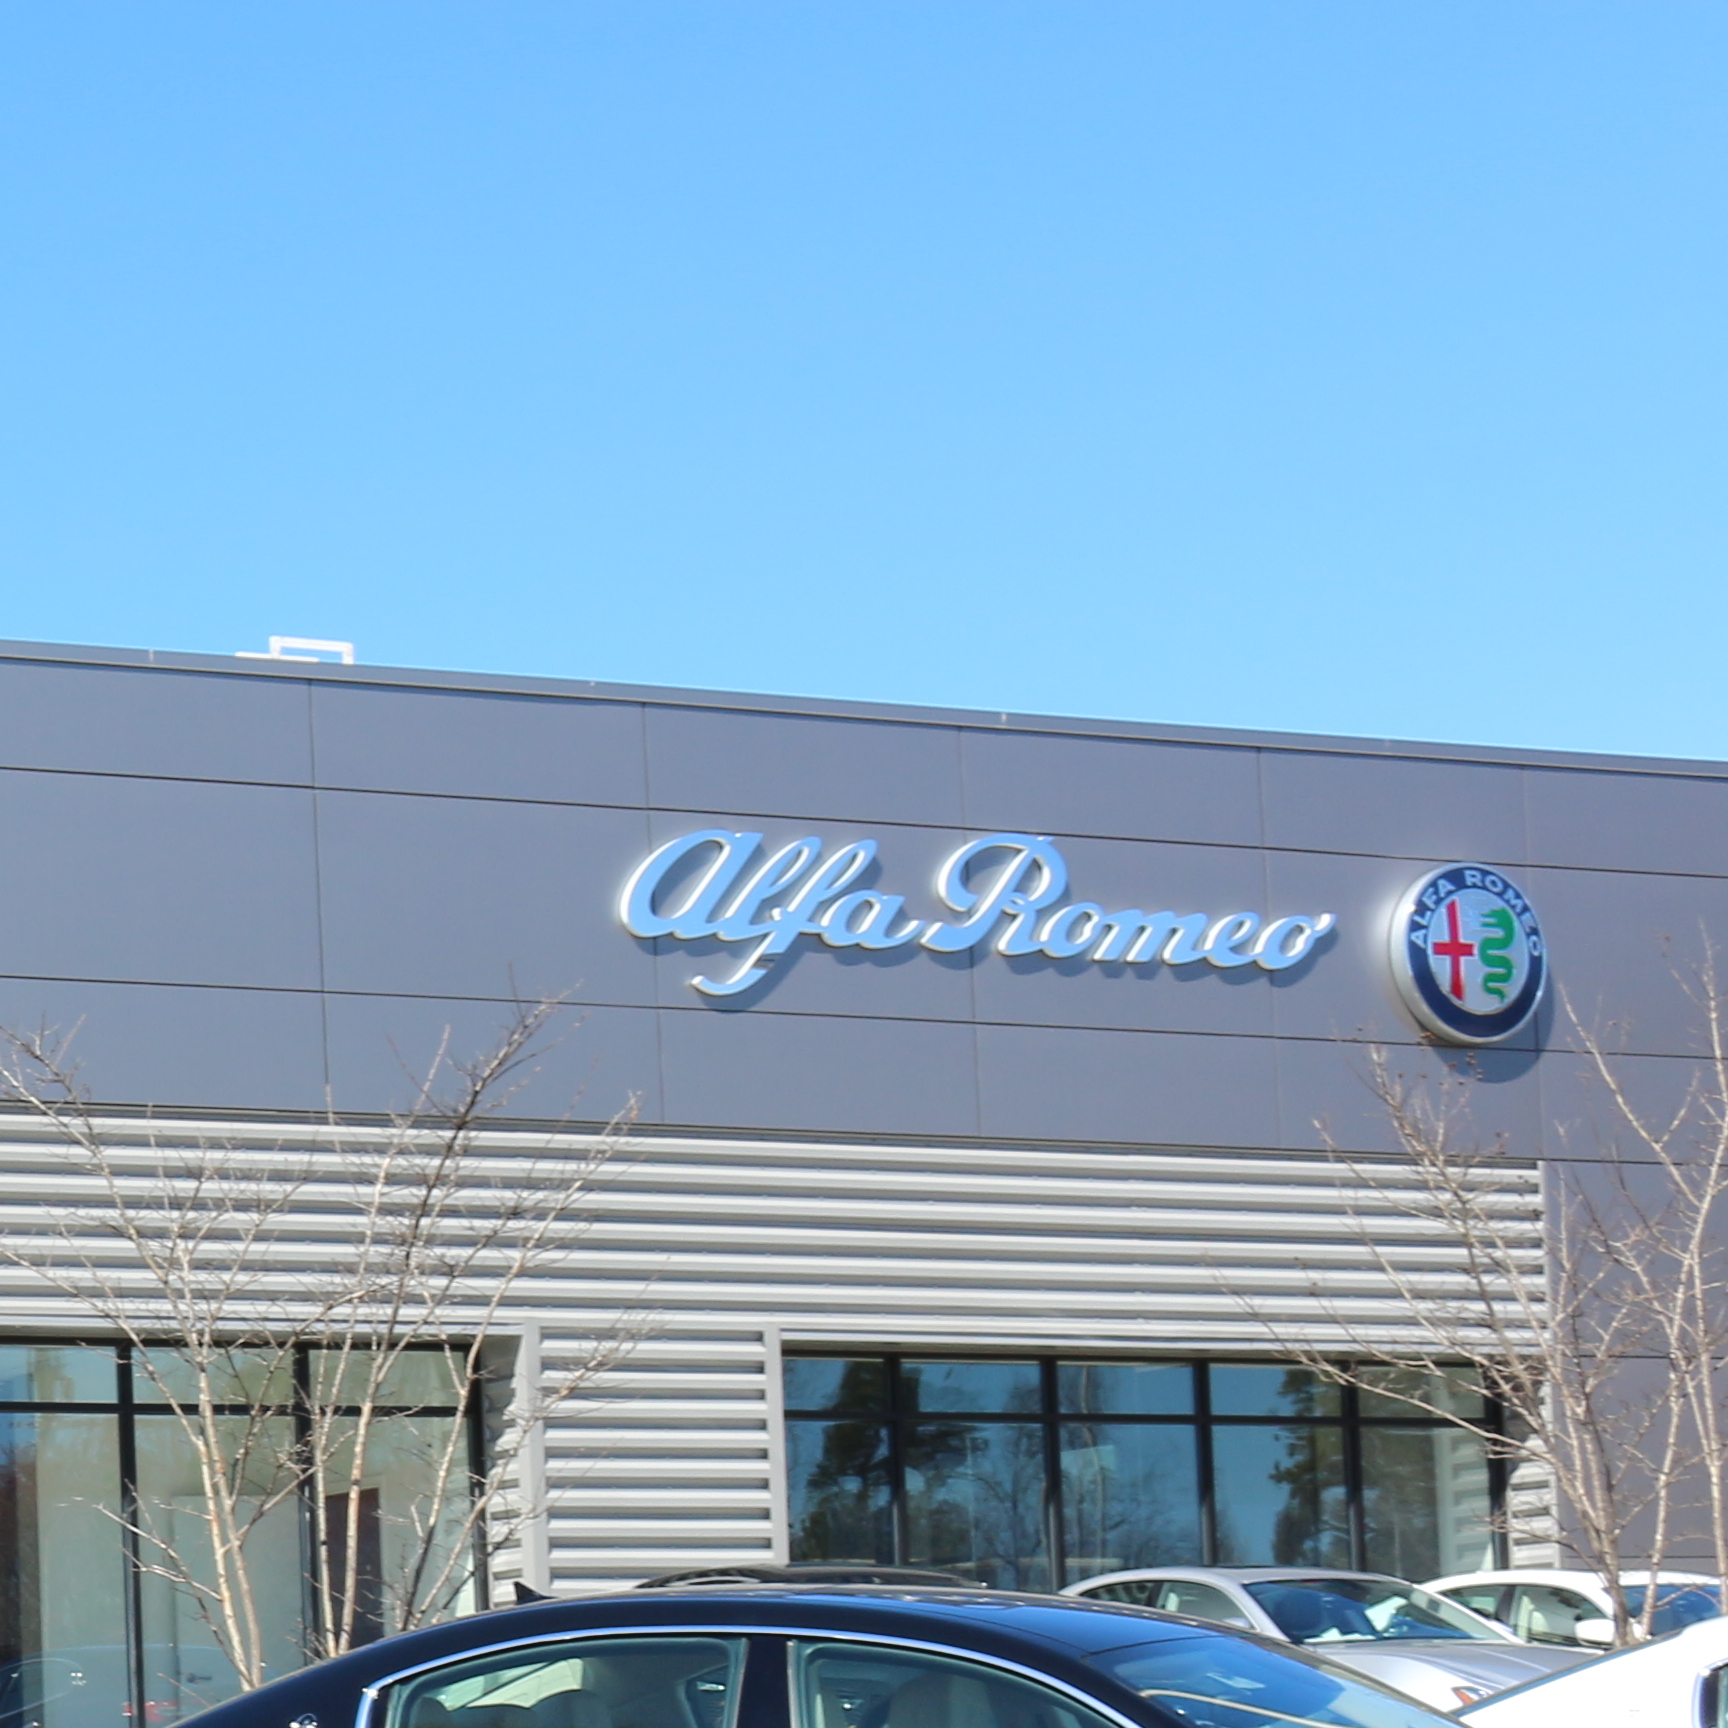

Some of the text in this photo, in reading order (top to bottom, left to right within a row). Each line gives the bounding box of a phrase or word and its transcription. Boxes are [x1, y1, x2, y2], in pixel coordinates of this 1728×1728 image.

[619, 829, 1335, 997] Alfa Romeo
[1410, 870, 1541, 956] ALFA ROMEO
